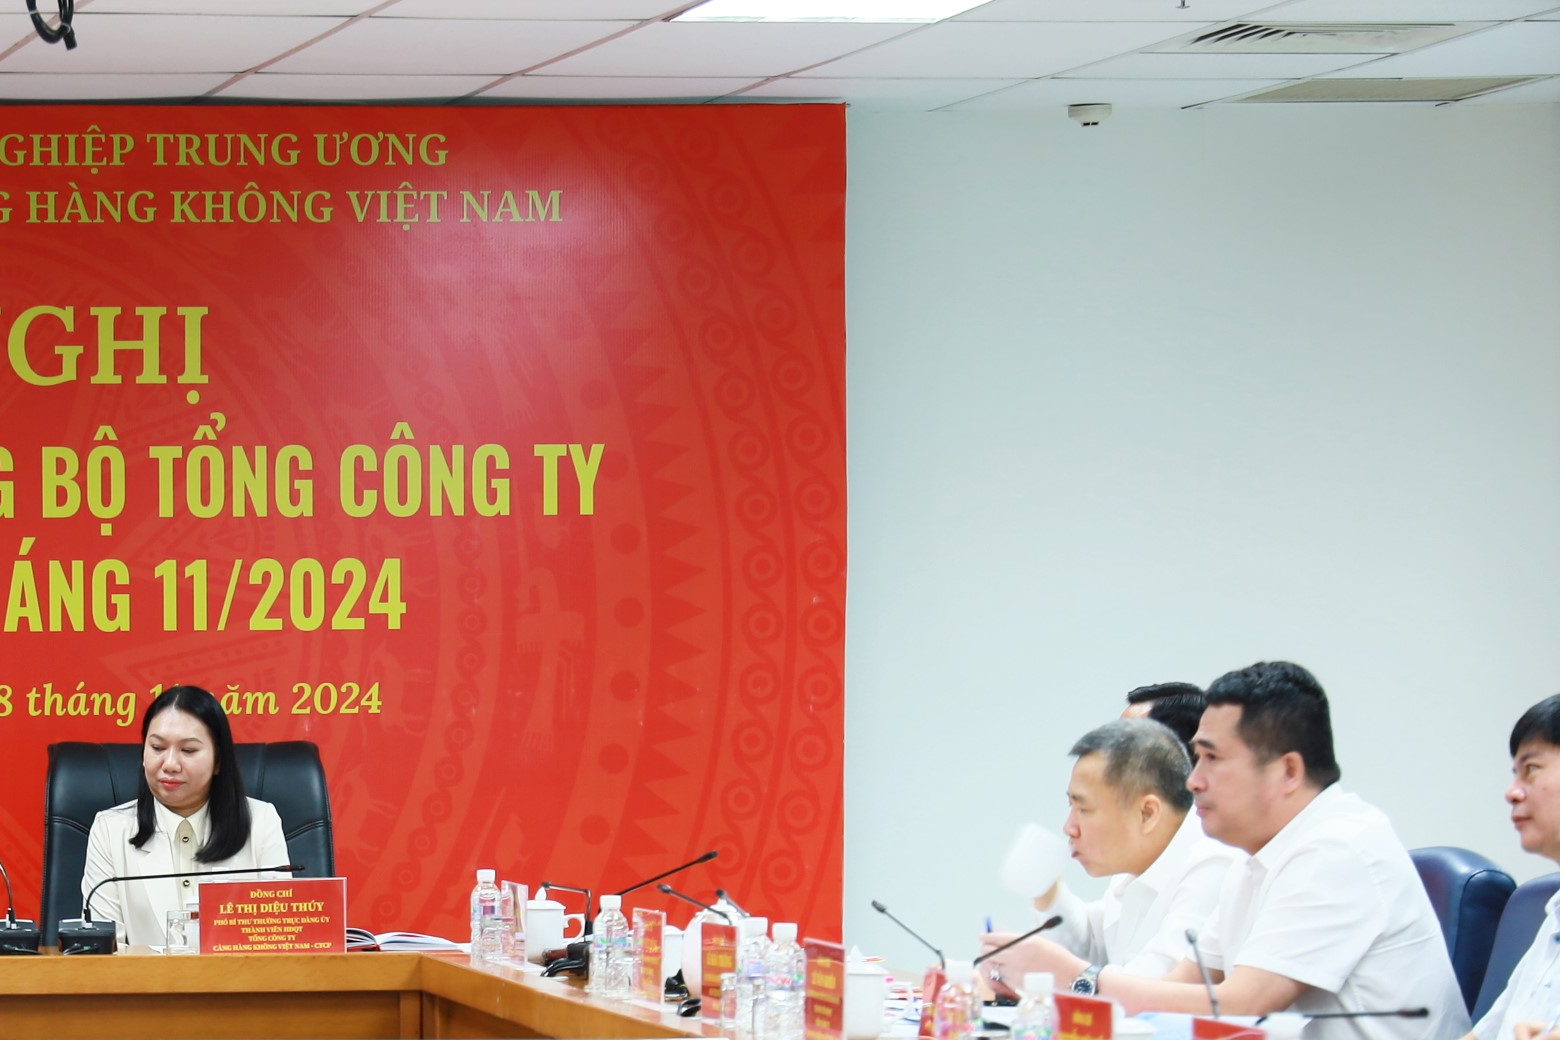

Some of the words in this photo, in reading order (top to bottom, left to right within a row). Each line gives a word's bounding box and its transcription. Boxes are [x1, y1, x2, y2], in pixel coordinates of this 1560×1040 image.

[146, 133, 300, 167] TRUNG
[315, 131, 449, 167] ƯƠNG
[26, 181, 157, 224] HÀNG
[170, 181, 334, 224] KHÔNG
[347, 181, 448, 232] VIỆT
[459, 189, 563, 222] NAM
[42, 425, 127, 537] BỘ
[149, 411, 315, 519] TỔNG
[340, 421, 511, 518] CÔNG
[533, 443, 606, 516] TY
[154, 557, 407, 632] 11/2024
[26, 681, 137, 727] tháng
[212, 684, 280, 717] ăm
[291, 681, 383, 715] 2024
[219, 902, 234, 914] LÊ
[236, 903, 257, 916] THỊ
[260, 901, 289, 915] DIỆU
[290, 900, 324, 912] THÚY
[250, 889, 275, 899] ĐỒNG
[276, 888, 293, 898] CHÍ
